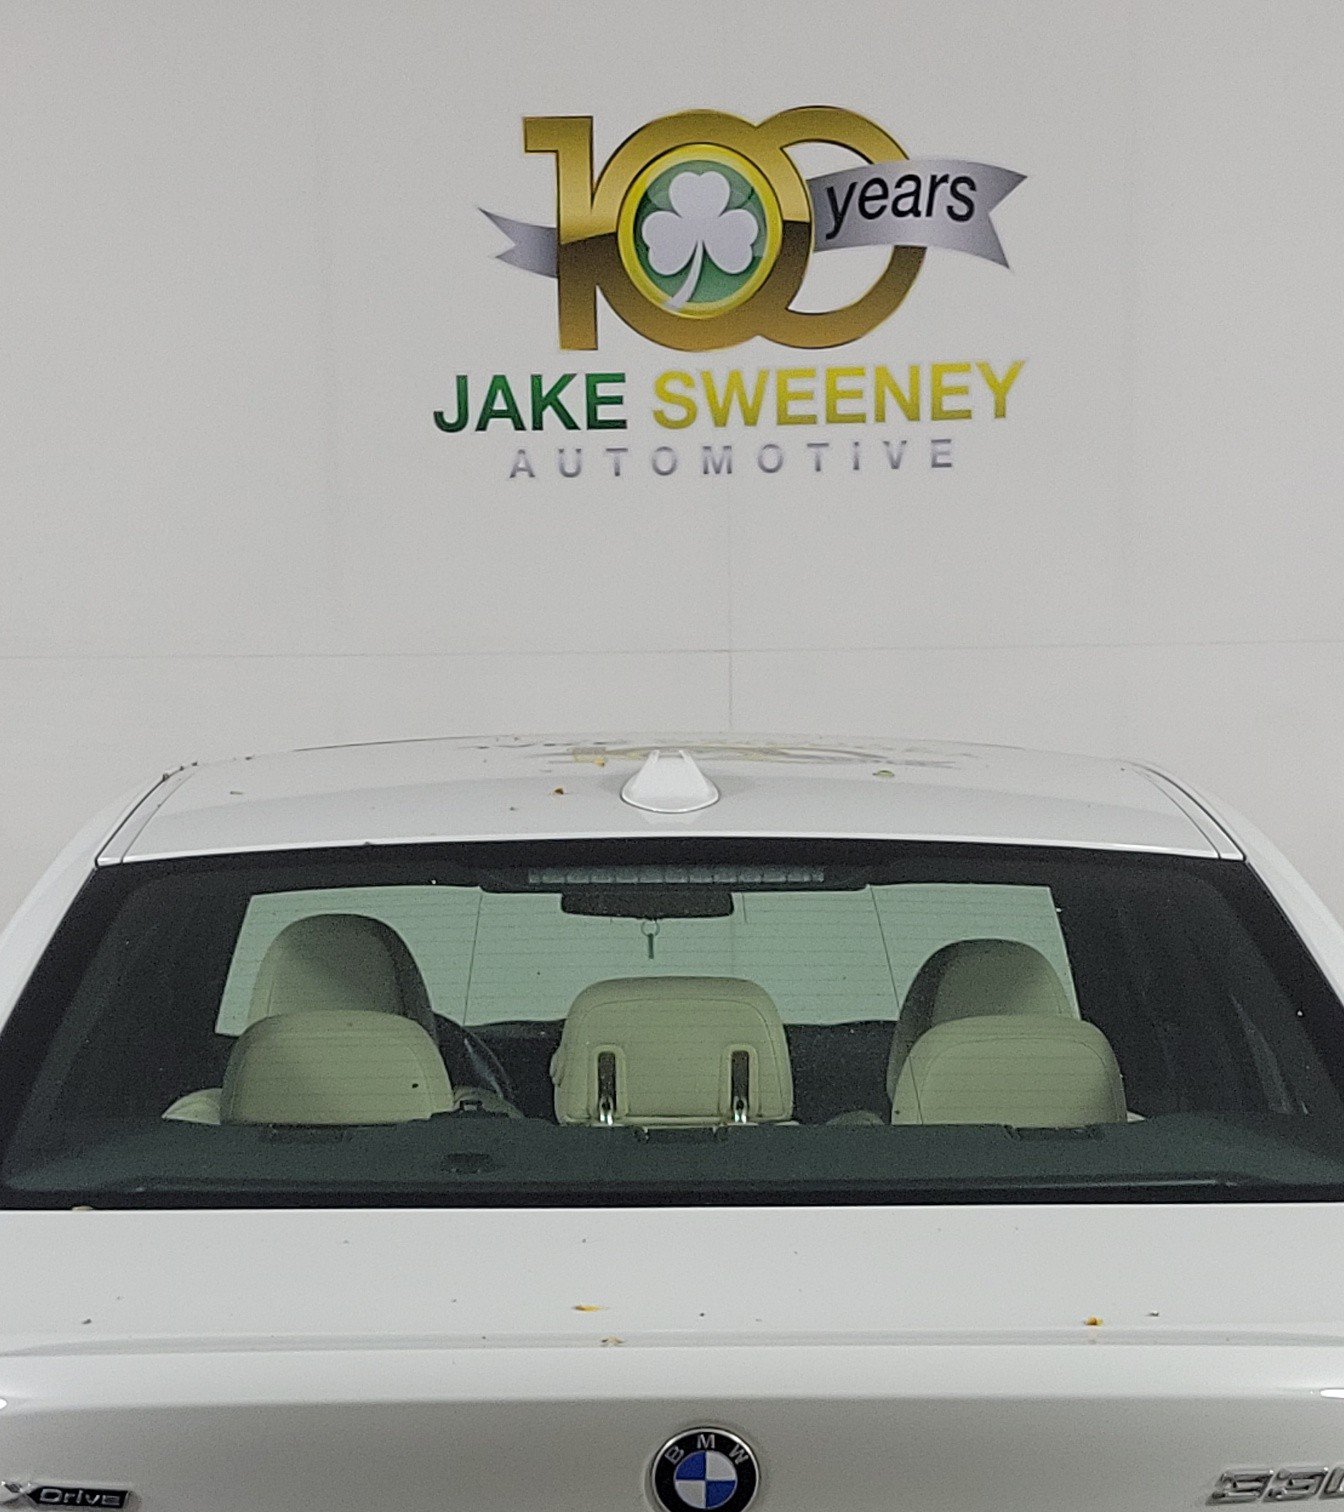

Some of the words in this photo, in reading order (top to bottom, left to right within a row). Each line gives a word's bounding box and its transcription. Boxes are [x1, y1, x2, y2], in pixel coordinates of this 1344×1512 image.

[825, 173, 977, 240] years
[433, 372, 628, 433] JAKE
[652, 360, 1026, 430] SWEENEY
[509, 439, 953, 479] AUTOMOTIVE
[665, 1434, 749, 1465] BMW
